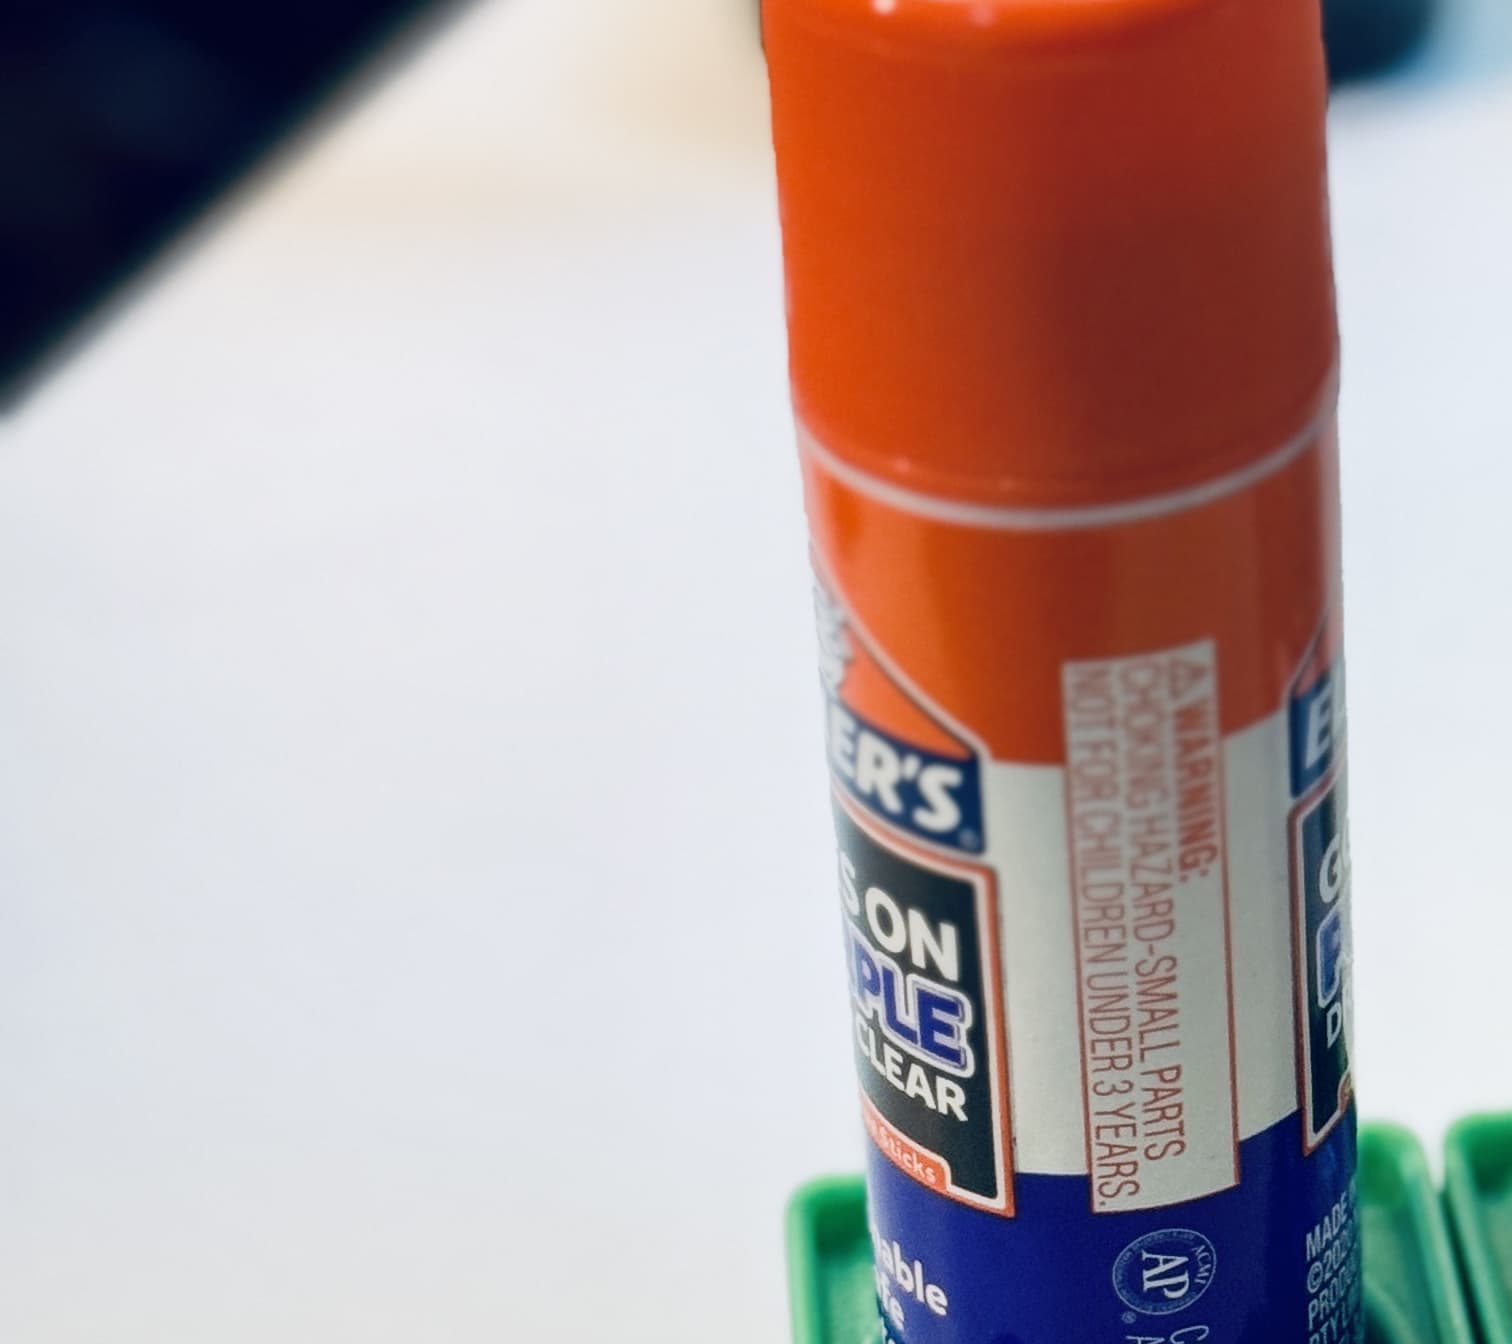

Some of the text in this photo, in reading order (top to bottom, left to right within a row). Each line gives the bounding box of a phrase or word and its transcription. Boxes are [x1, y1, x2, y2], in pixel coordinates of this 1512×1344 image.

[865, 886, 959, 982] ON
[1077, 810, 1127, 964] CHILDREN
[855, 1012, 968, 1122] CLEAR
[1086, 971, 1133, 1073] UNDER
[1092, 1079, 1134, 1097] 3
[1140, 1063, 1186, 1162] PARTS
[1094, 1102, 1140, 1207] YEARS.
[1141, 1249, 1190, 1299] AP
[1306, 1191, 1347, 1261] MADE
